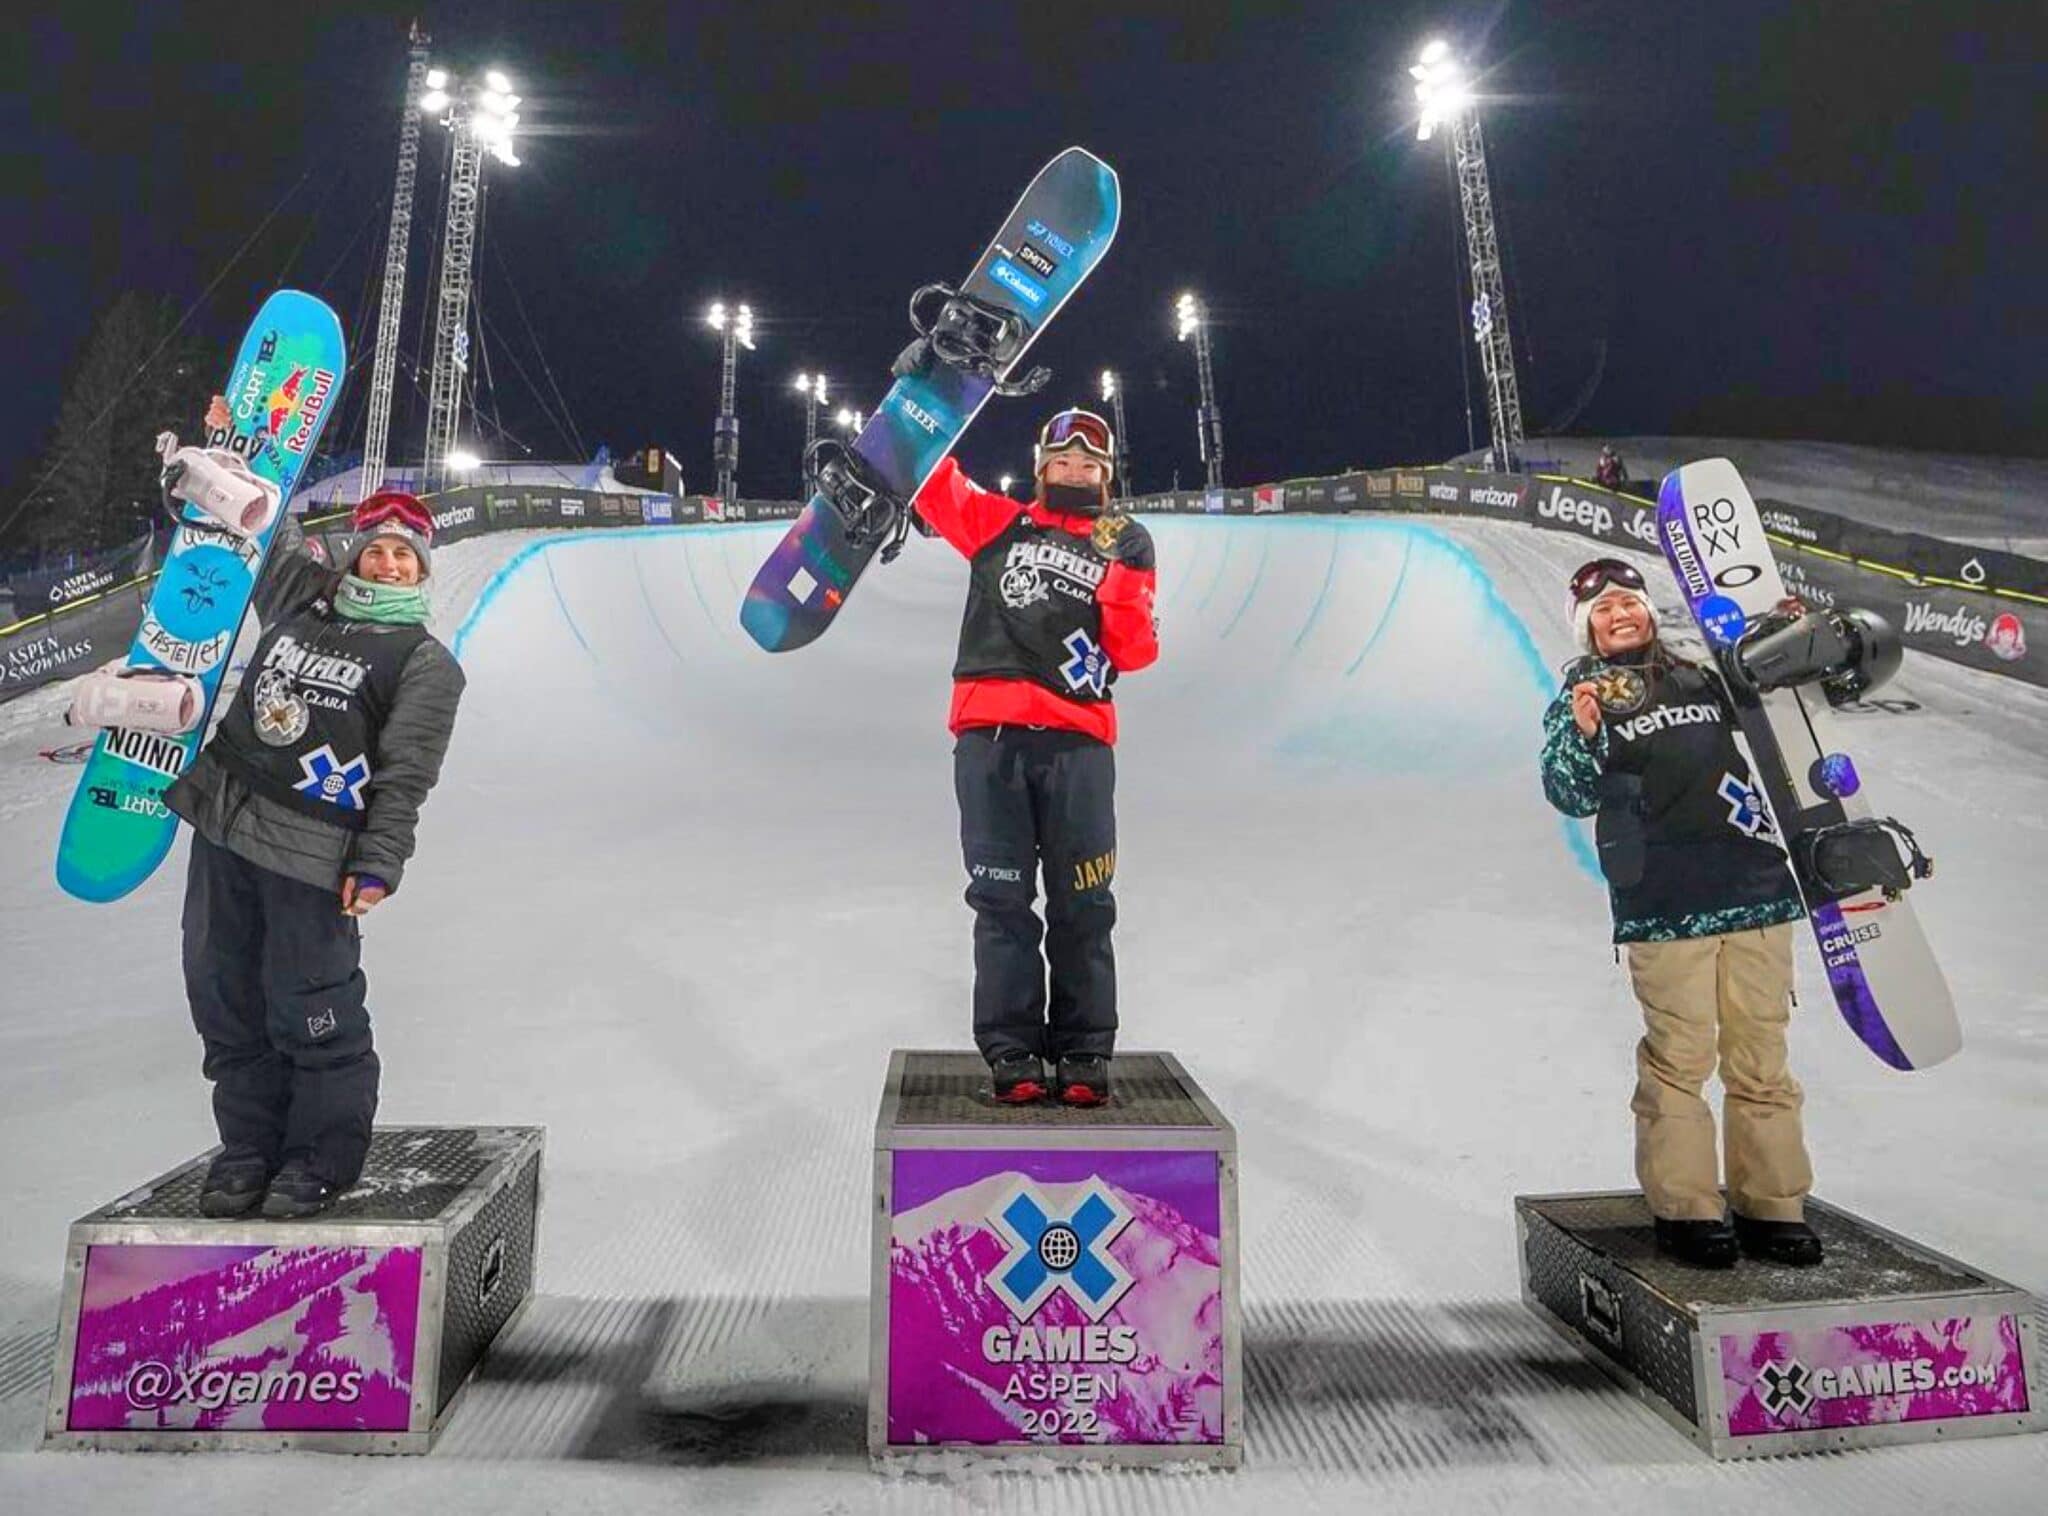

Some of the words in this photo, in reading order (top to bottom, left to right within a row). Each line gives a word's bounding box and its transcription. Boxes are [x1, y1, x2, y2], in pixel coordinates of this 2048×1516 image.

[1020, 246, 1054, 275] SMITH
[237, 366, 267, 419] CART
[285, 411, 318, 453] Red
[304, 369, 334, 412] Bull
[902, 399, 939, 435] SLEEK
[208, 424, 265, 461] play
[1469, 487, 1518, 509] verizon
[1537, 486, 1613, 536] Jeep
[431, 506, 475, 530] verizon
[1622, 508, 1660, 546] Je
[1904, 602, 1986, 646] Wendy's
[8, 636, 60, 666] ASPEN
[8, 640, 92, 681] SNOWMASS
[302, 689, 349, 712] CLARA
[1614, 704, 1723, 742] verizon
[105, 726, 185, 775] UNION
[120, 794, 171, 818] CART
[987, 868, 1020, 882] YONEX
[1822, 923, 1882, 954] CRUISE
[981, 1324, 1139, 1364] GAMES
[125, 1361, 363, 1411] @xgames
[1002, 1372, 1120, 1402] ASPEN
[1021, 1408, 1099, 1436] 2022
